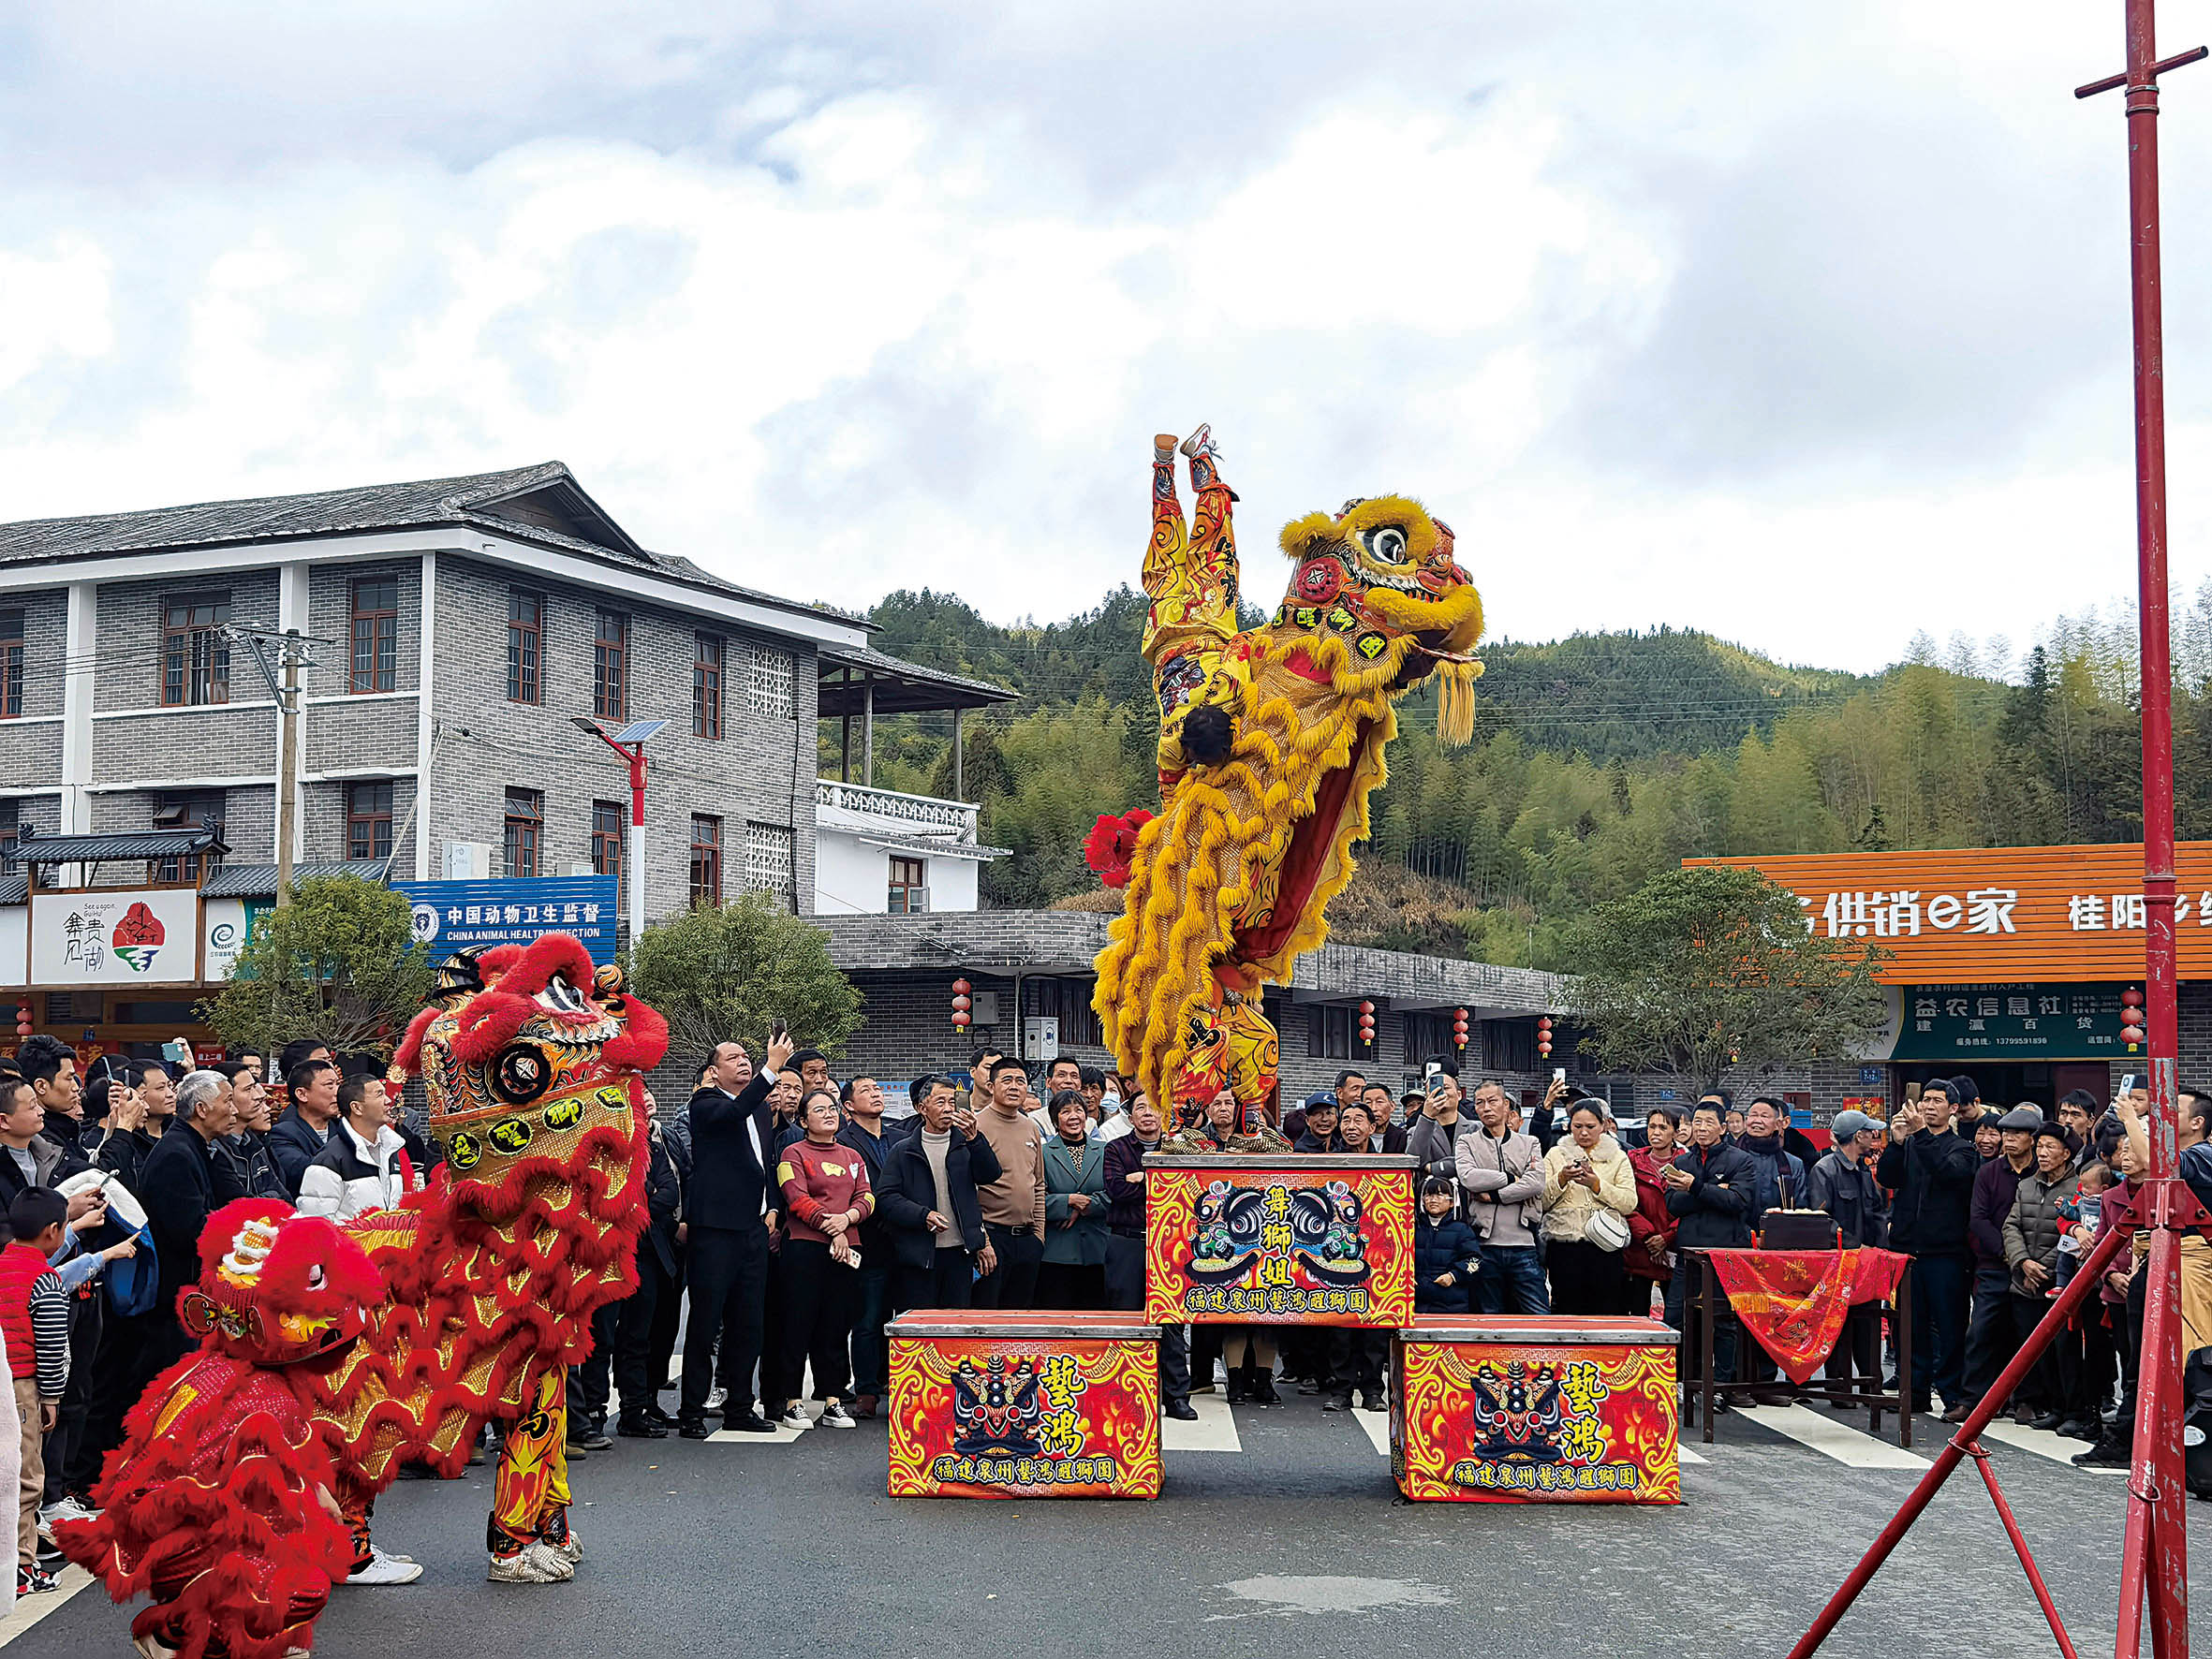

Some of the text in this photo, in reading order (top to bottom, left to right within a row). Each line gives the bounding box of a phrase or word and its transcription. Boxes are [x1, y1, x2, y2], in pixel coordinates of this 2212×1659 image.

[448, 903, 600, 926] 中国动物卫生监督
[1821, 887, 2018, 937] 供销e家
[447, 931, 475, 941] CHINA
[476, 930, 510, 940] ANIMAL
[1915, 996, 2061, 1017] 益农信息社
